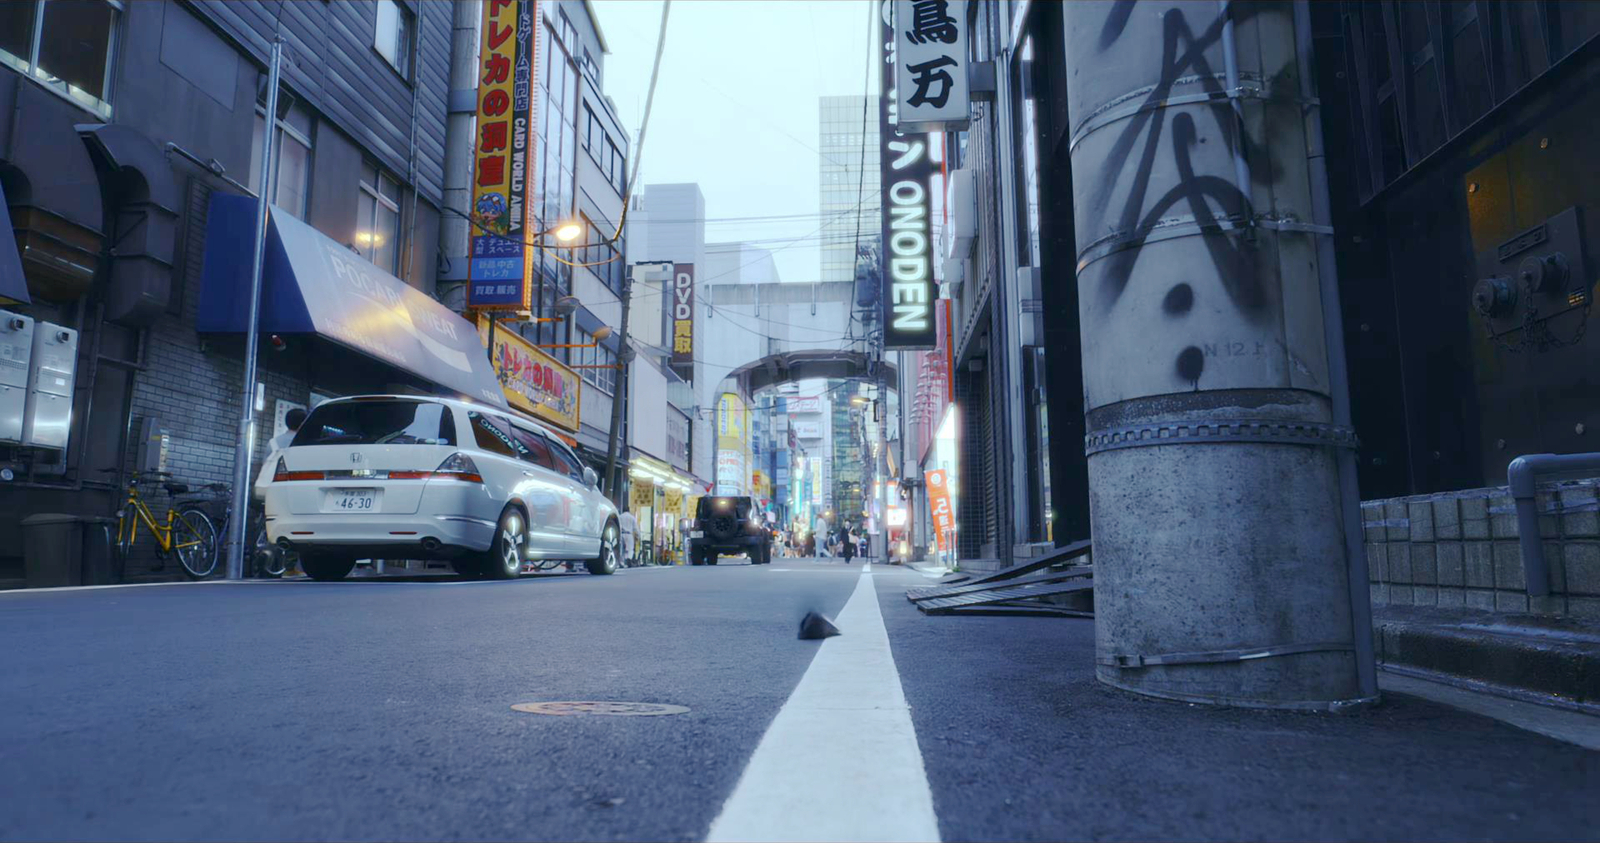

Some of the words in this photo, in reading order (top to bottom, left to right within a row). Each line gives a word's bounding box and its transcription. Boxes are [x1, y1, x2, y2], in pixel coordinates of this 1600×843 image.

[514, 118, 526, 149] CARD
[511, 151, 524, 192] WORLD
[509, 194, 522, 231] AKIBA
[889, 180, 926, 329] ONODEN
[676, 272, 692, 320] DVD
[674, 320, 692, 353] 買取
[341, 497, 372, 509] 46-30
